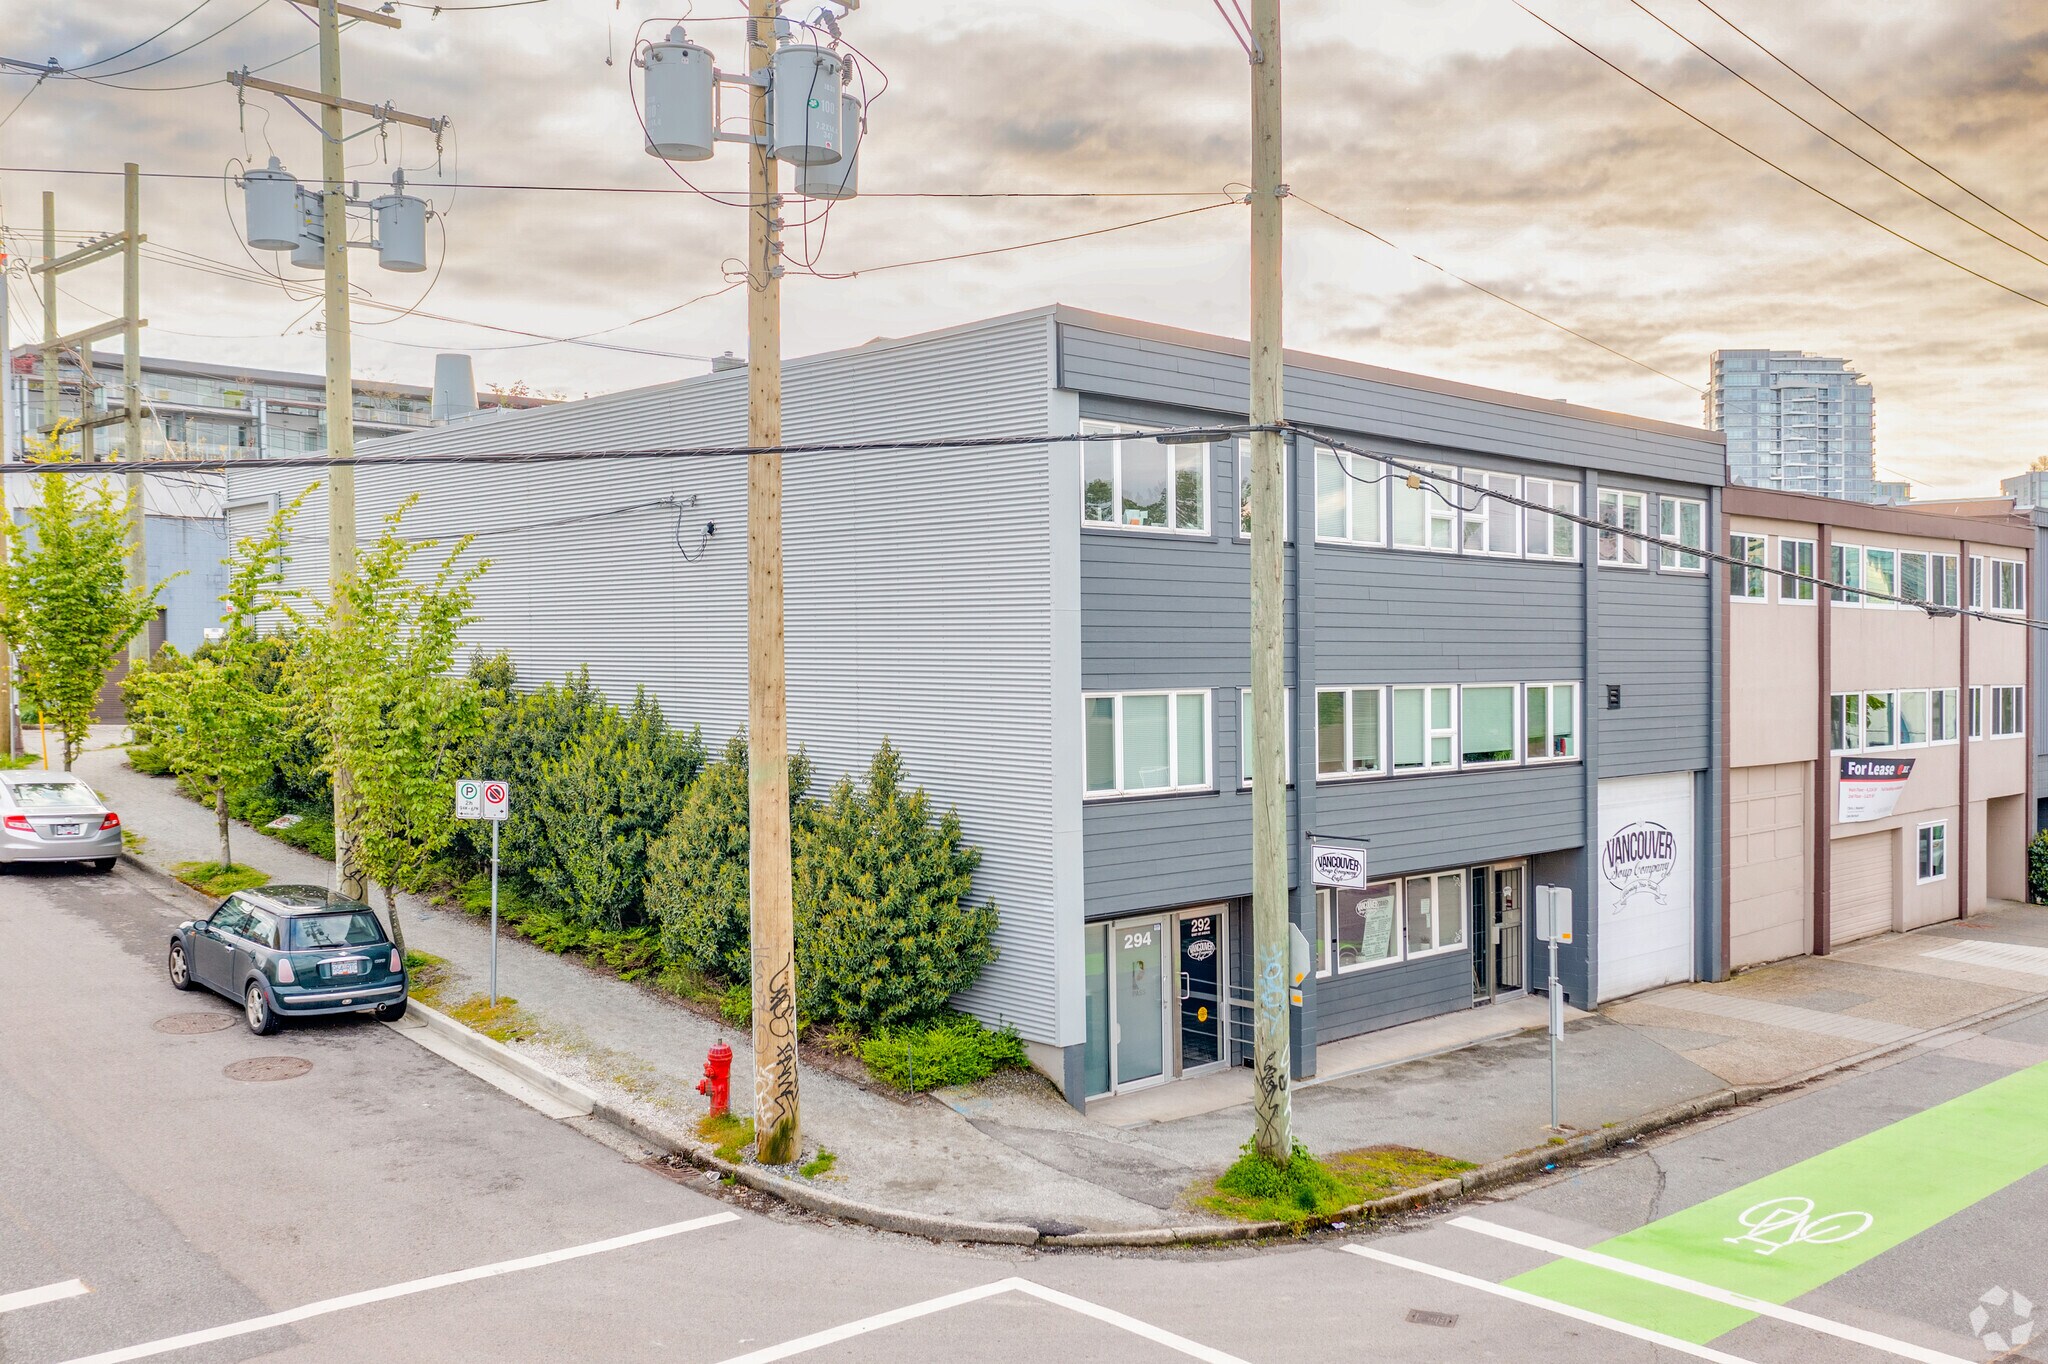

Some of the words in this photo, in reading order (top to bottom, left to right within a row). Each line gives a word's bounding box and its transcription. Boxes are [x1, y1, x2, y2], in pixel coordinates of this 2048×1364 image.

[821, 99, 835, 114] 100
[1848, 761, 1867, 776] For
[1868, 762, 1895, 776] Lease
[466, 786, 474, 796] P
[1606, 830, 1673, 868] VANCOUVER
[1317, 856, 1359, 871] VANCOUVER
[1634, 861, 1670, 879] Company
[1191, 917, 1210, 932] 292
[1124, 931, 1152, 949] 294
